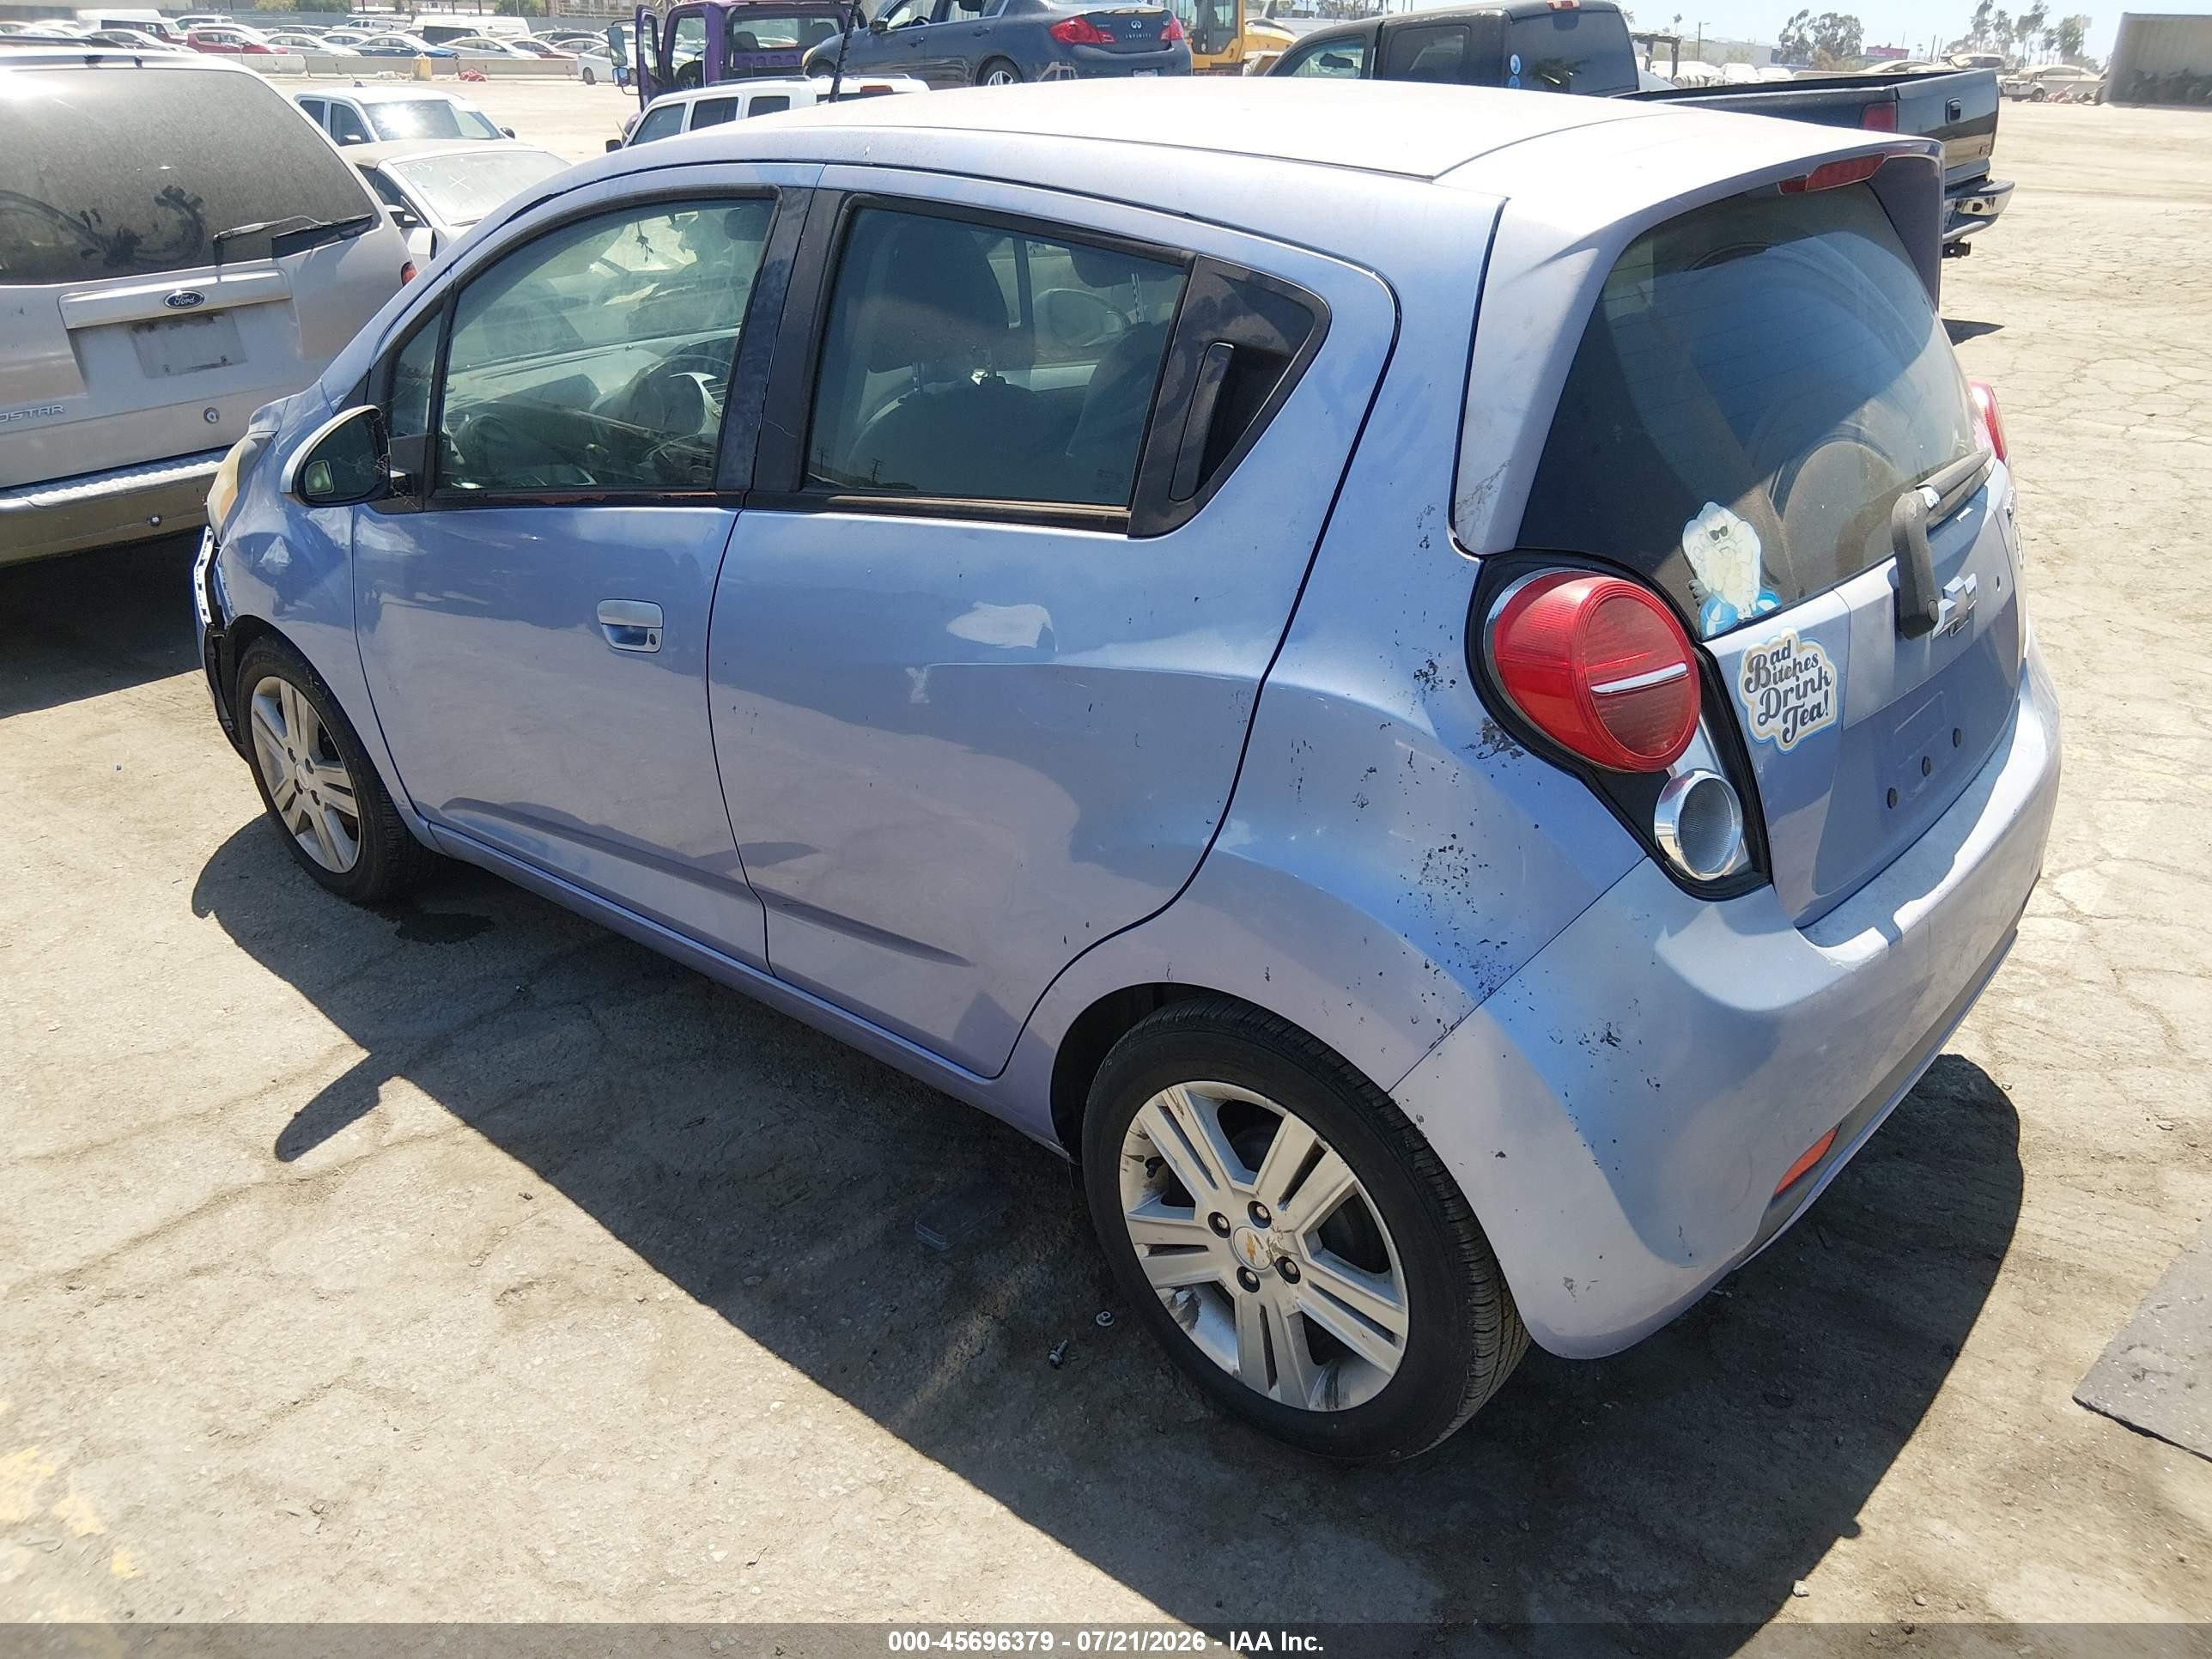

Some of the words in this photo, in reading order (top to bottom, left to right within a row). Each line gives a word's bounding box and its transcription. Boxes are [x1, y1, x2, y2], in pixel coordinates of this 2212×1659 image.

[173, 294, 195, 306] Ford
[1744, 653, 1820, 694] Bitches
[1757, 666, 1832, 726] Drink
[1782, 690, 1829, 744] Tea!
